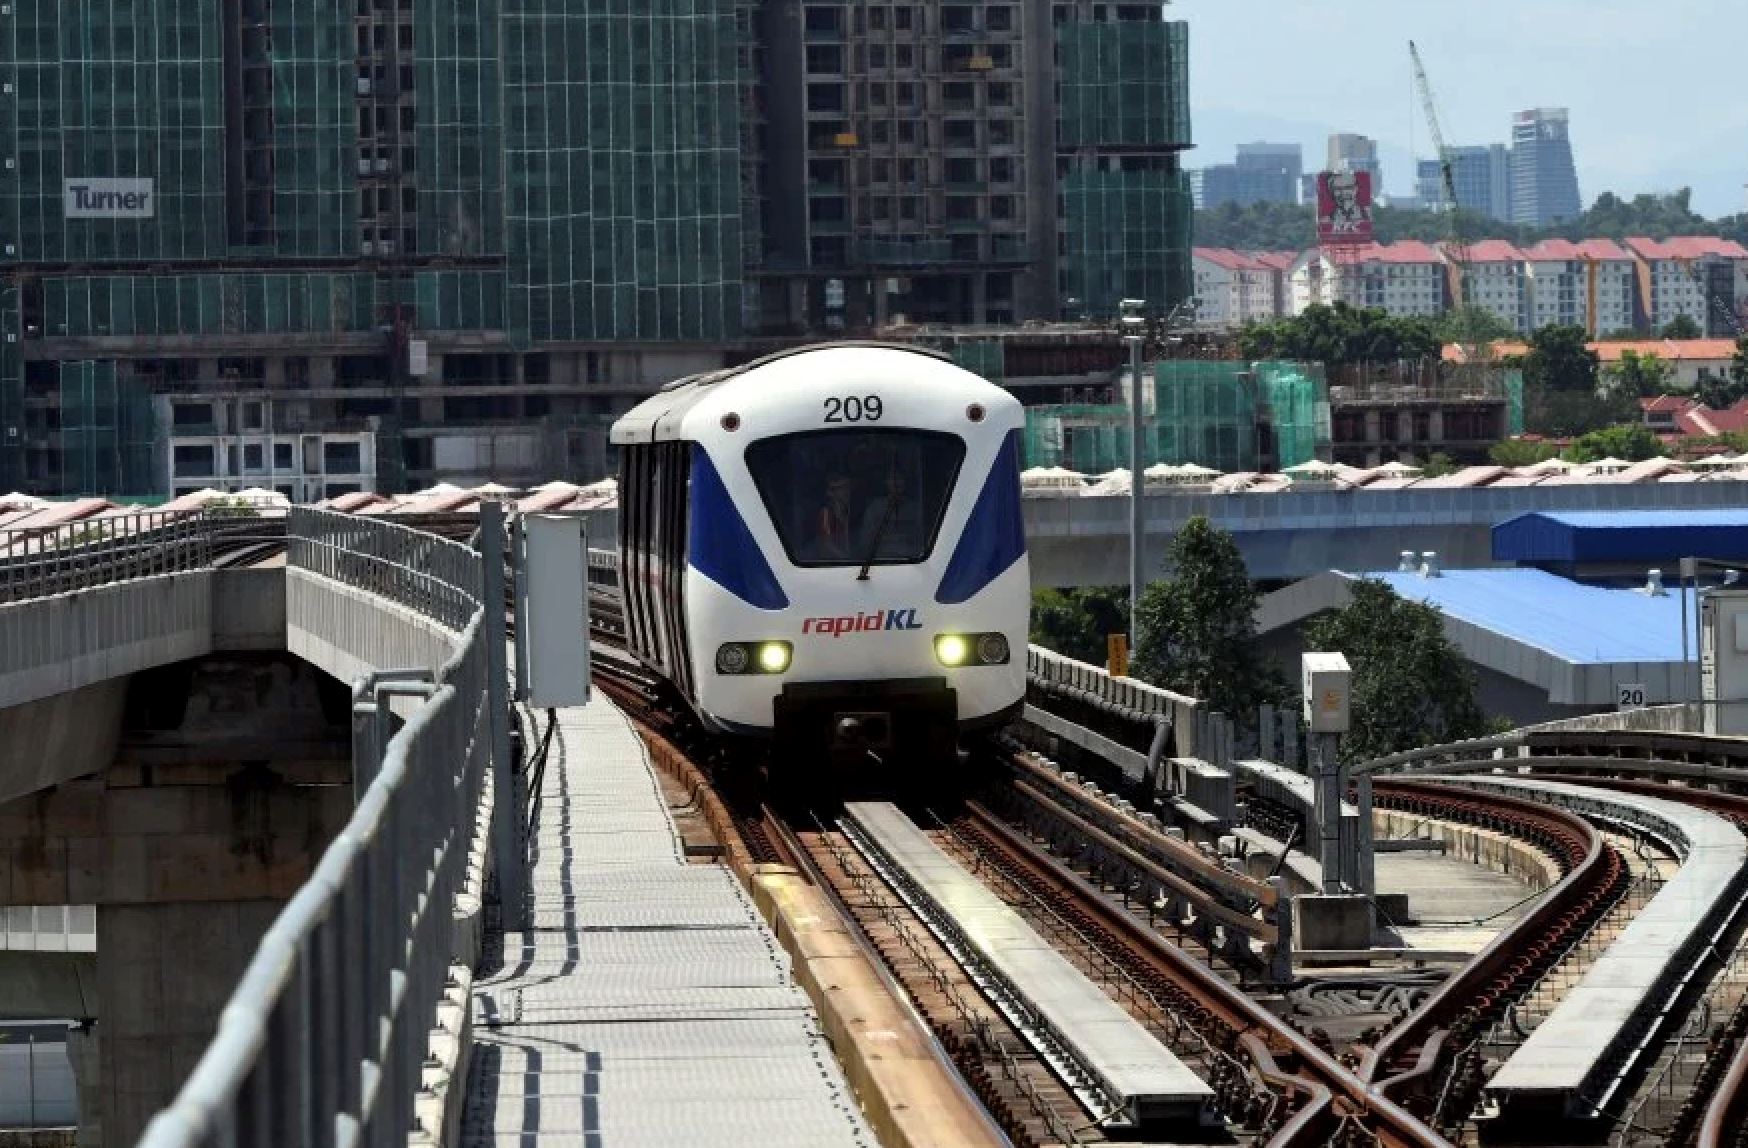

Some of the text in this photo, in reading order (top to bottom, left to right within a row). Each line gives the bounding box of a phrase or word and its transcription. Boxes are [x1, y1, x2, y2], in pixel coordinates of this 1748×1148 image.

[70, 186, 148, 209] Turner
[824, 396, 882, 422] 209
[802, 608, 922, 638] rapidKL
[1621, 690, 1642, 704] 20
